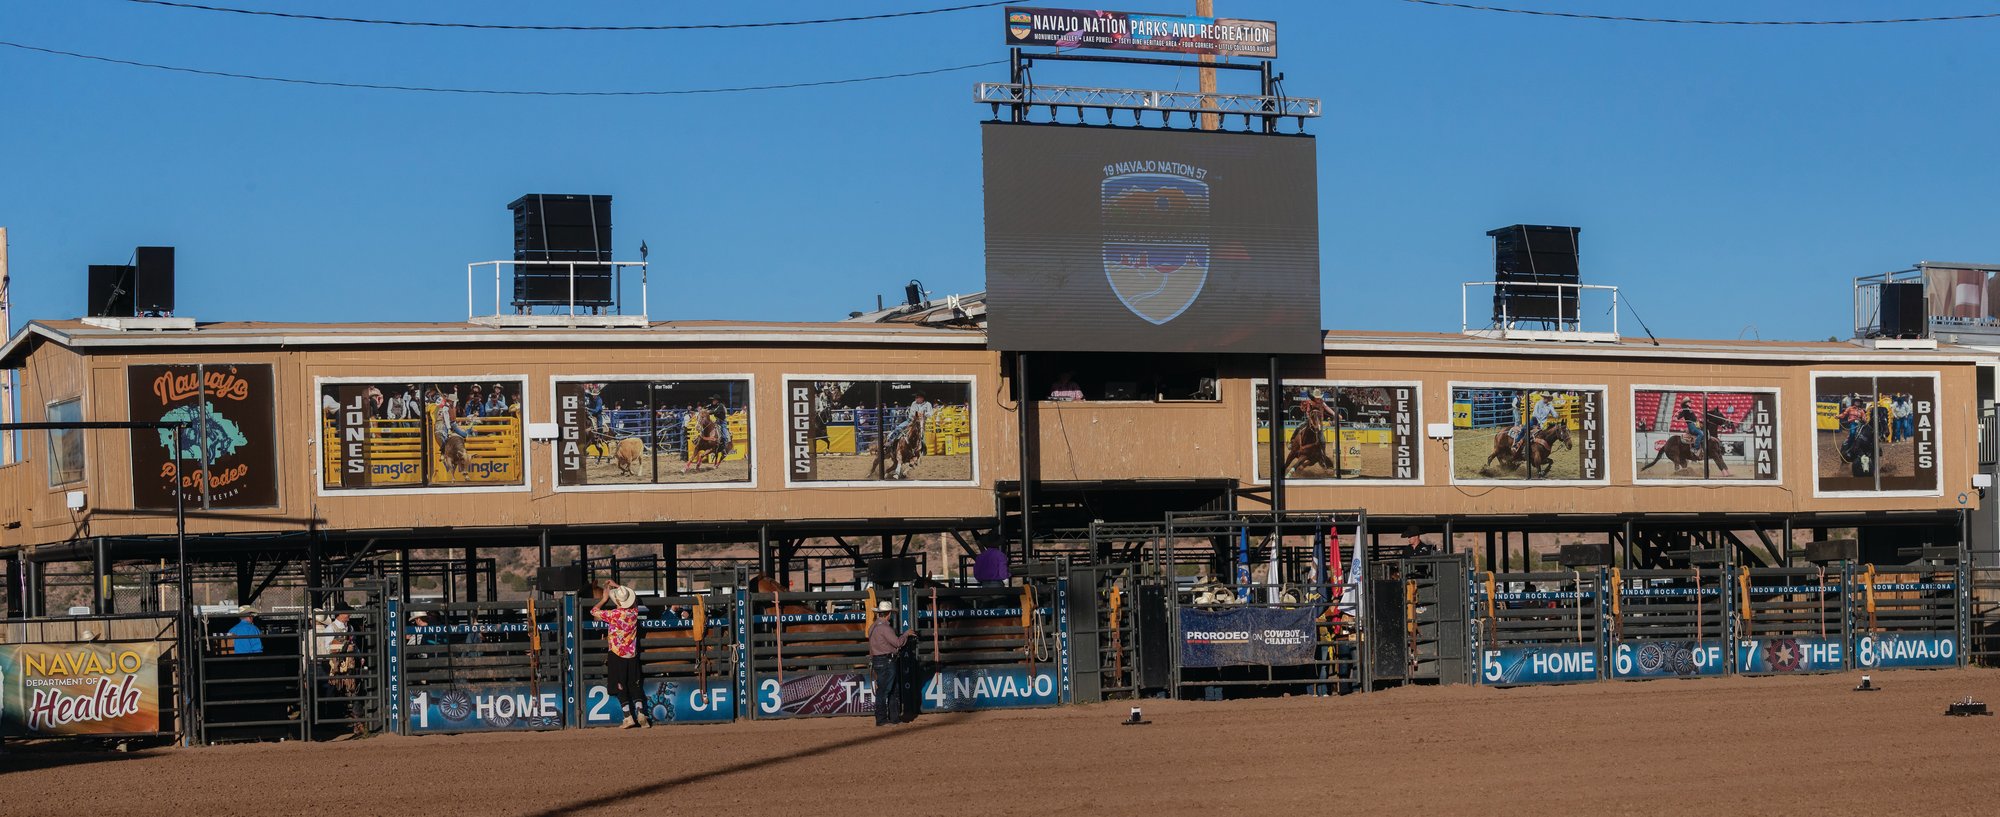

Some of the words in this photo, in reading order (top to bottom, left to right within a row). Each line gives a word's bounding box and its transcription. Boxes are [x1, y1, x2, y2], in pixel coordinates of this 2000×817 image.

[1033, 14, 1078, 31] NAVAJO
[1083, 17, 1126, 34] NATION
[1131, 20, 1168, 37] PARKS
[1172, 22, 1195, 38] AND
[1200, 24, 1269, 43] RECREATION
[1034, 33, 1059, 41] MONUMENT
[1060, 34, 1078, 42] VALLEY
[1095, 36, 1113, 44] POWELL
[1143, 39, 1165, 47] HERITAGE
[1103, 164, 1114, 177] 19
[1115, 160, 1157, 175] NAVAJO
[1158, 160, 1195, 177] NATION
[1195, 168, 1208, 180] 57
[346, 395, 365, 474] JONES
[562, 395, 581, 471] BEGAY
[792, 387, 811, 474] ROGERS
[1396, 388, 1412, 478] DENNISON
[1583, 392, 1597, 479] TSINIGINE
[1754, 400, 1773, 474] LOWMAN
[1917, 400, 1933, 469] BATES
[415, 626, 458, 634] WINDOW
[503, 624, 550, 632] ARIZNA
[926, 609, 964, 617] WNDOW
[970, 609, 1000, 617] ROCK,
[1187, 631, 1249, 640] PRORODEO
[1252, 633, 1262, 641] ON
[1264, 629, 1301, 638] COWBOY
[1860, 636, 1875, 666] 8
[1881, 639, 1953, 660] NAVAJO
[25, 651, 142, 677] NAVAJO
[1061, 631, 1069, 691] BIKEYAH
[1485, 650, 1503, 681] 5
[1533, 651, 1595, 674] HOME
[1616, 644, 1632, 674] 6
[1692, 646, 1720, 667] OF
[1741, 640, 1758, 671] 7
[1800, 643, 1840, 663] THE
[26, 678, 83, 687] DEPARTMENT
[85, 677, 98, 685] OF
[391, 655, 399, 720] BIKEYAH
[761, 679, 782, 714] 3
[840, 673, 876, 704] TH
[925, 672, 946, 707] 4
[954, 674, 1053, 699] NAVAJO
[29, 675, 140, 729] Health
[411, 692, 428, 728] 1
[476, 693, 557, 720] HOME
[588, 686, 611, 721] 2
[690, 688, 727, 712] OF
